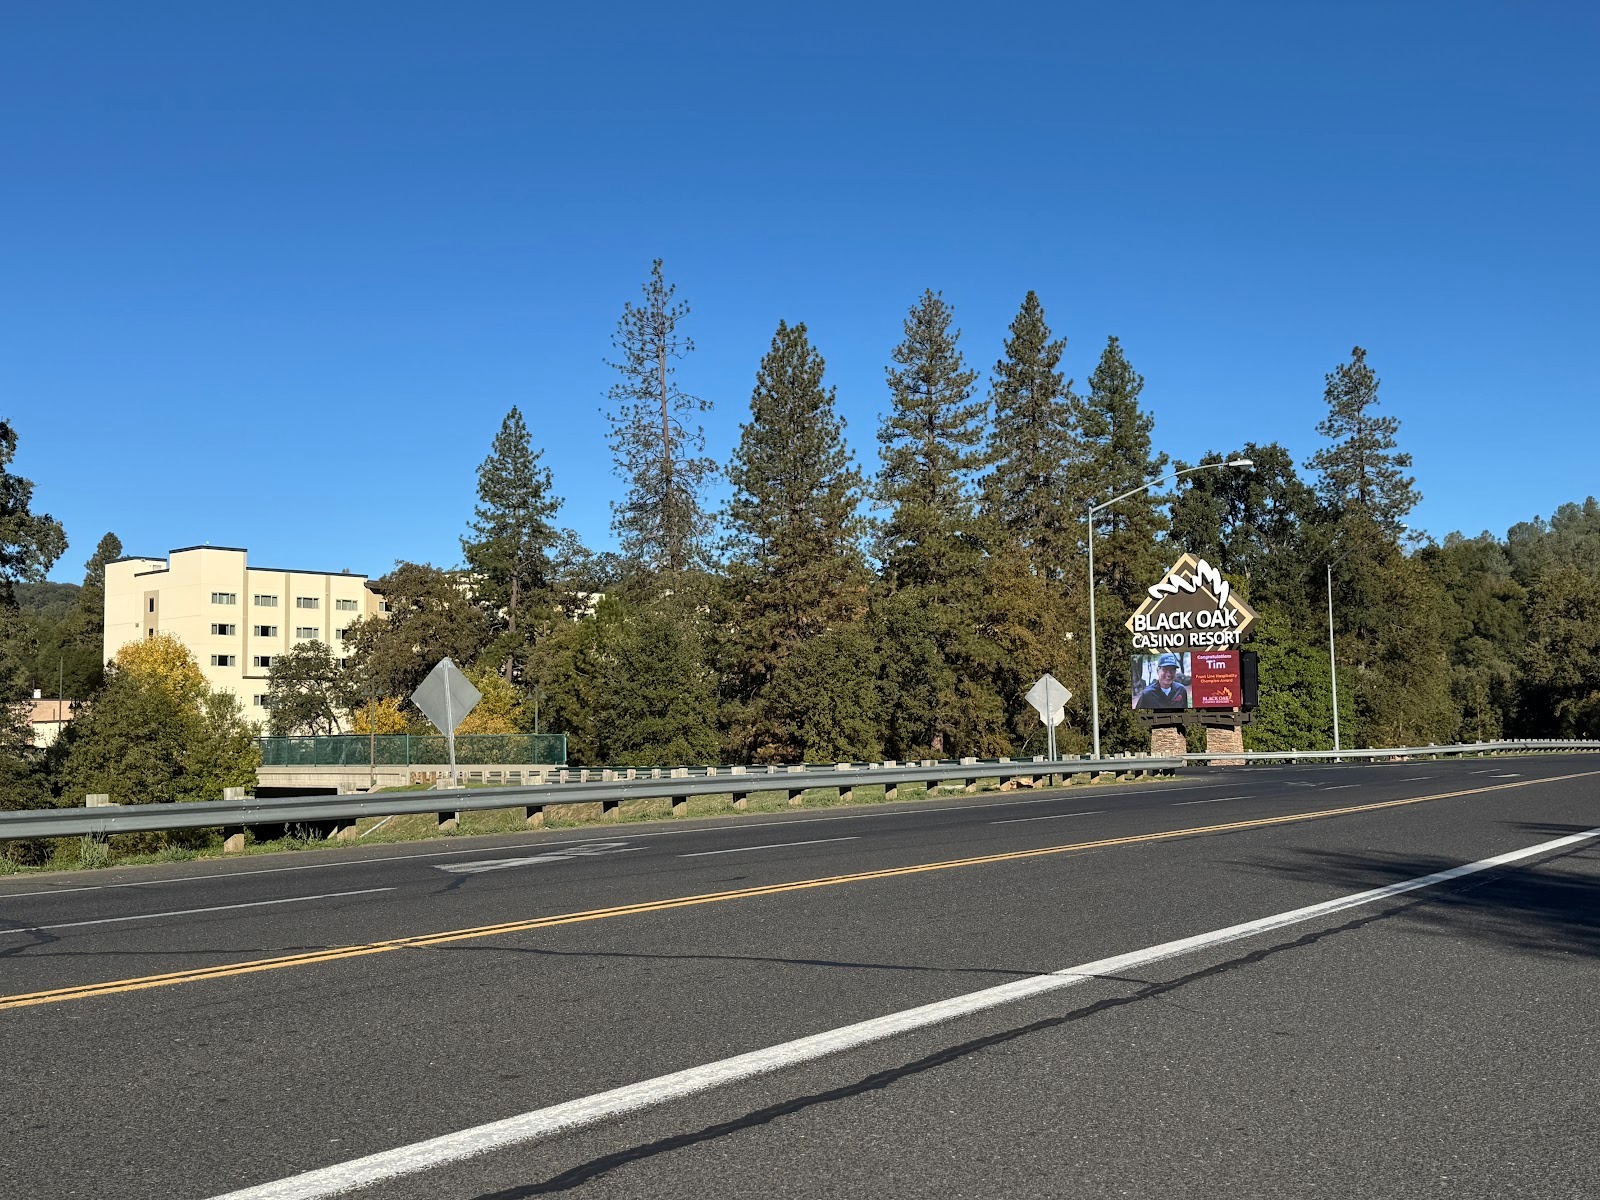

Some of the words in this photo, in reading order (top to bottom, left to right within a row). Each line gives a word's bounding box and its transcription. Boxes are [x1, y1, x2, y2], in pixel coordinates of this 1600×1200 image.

[1134, 611, 1193, 632] BLACK
[1196, 608, 1239, 628] OAK
[1132, 633, 1185, 648] CASINO
[1189, 631, 1242, 646] RESORT
[1206, 660, 1226, 669] Tim
